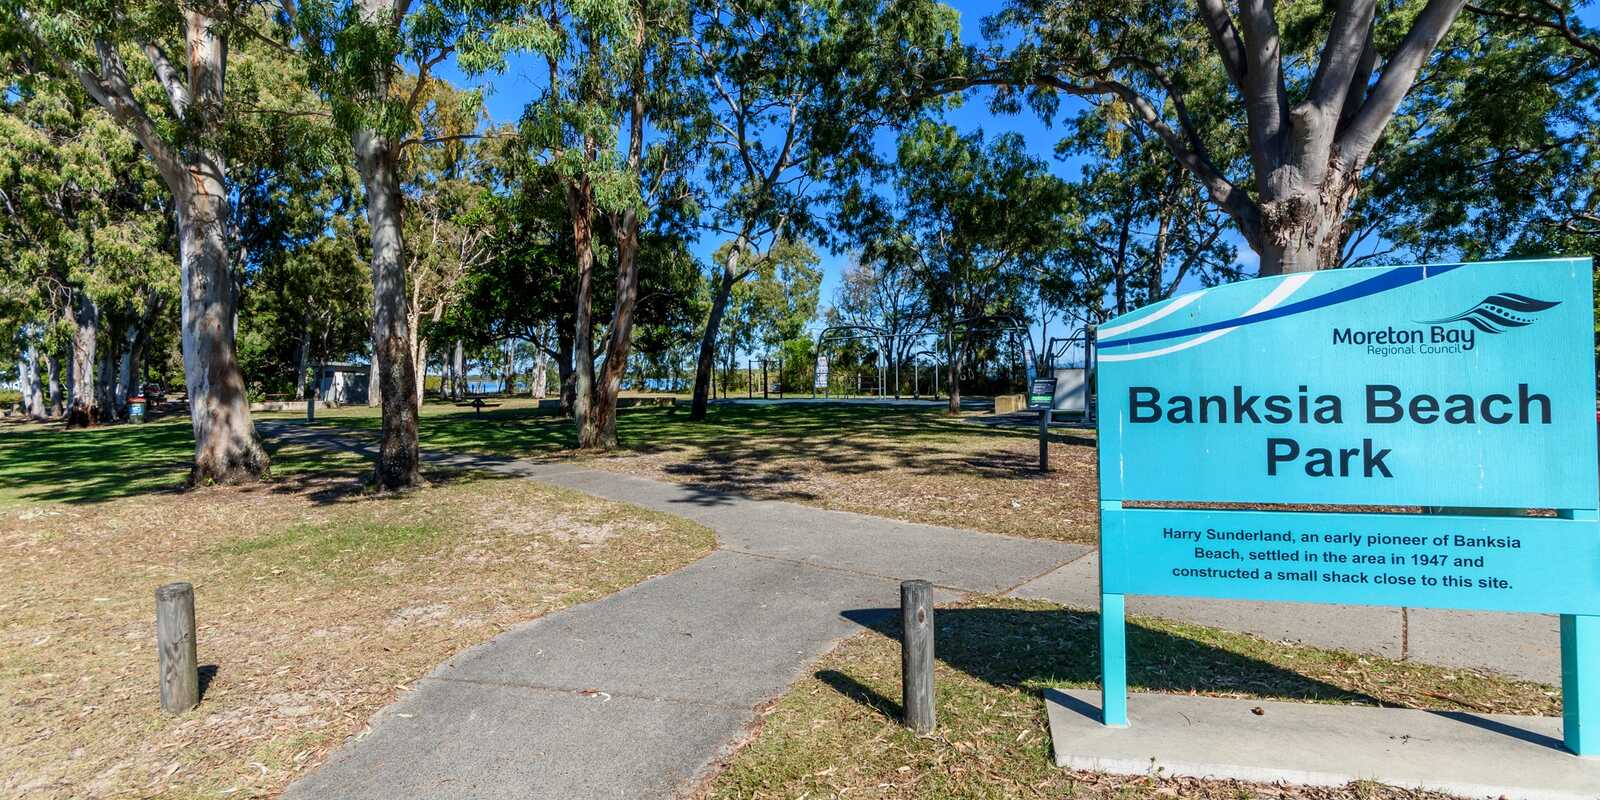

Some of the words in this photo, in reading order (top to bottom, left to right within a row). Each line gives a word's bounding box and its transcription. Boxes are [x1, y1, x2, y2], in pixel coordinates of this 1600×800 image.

[1333, 327, 1424, 345] Moreton
[1429, 325, 1476, 351] Bay
[1368, 343, 1415, 357] Regional
[1420, 344, 1462, 354] Council
[1129, 385, 1343, 424] Banksia
[1366, 384, 1551, 424] Beach
[1267, 438, 1393, 477] Park
[1164, 528, 1201, 543] Harry
[1206, 529, 1296, 546] Sunderland,
[1301, 534, 1318, 543] an
[1324, 533, 1361, 547] early
[1368, 533, 1427, 548] pioneer
[1433, 535, 1449, 547] of
[1455, 535, 1520, 549] Banksia
[1195, 547, 1243, 562] Beach,
[1249, 550, 1299, 562] settled
[1305, 551, 1317, 563] in
[1323, 552, 1347, 564] the
[1352, 555, 1385, 565] area
[1392, 553, 1405, 566] in
[1411, 554, 1448, 567] 1947
[1454, 556, 1483, 568] and
[1173, 568, 1259, 580] constructed
[1263, 571, 1273, 580] a
[1278, 570, 1317, 582] small
[1323, 571, 1368, 584] shack
[1374, 573, 1416, 586] close
[1421, 575, 1437, 587] to
[1443, 576, 1472, 588] this
[1479, 577, 1512, 590] site.
